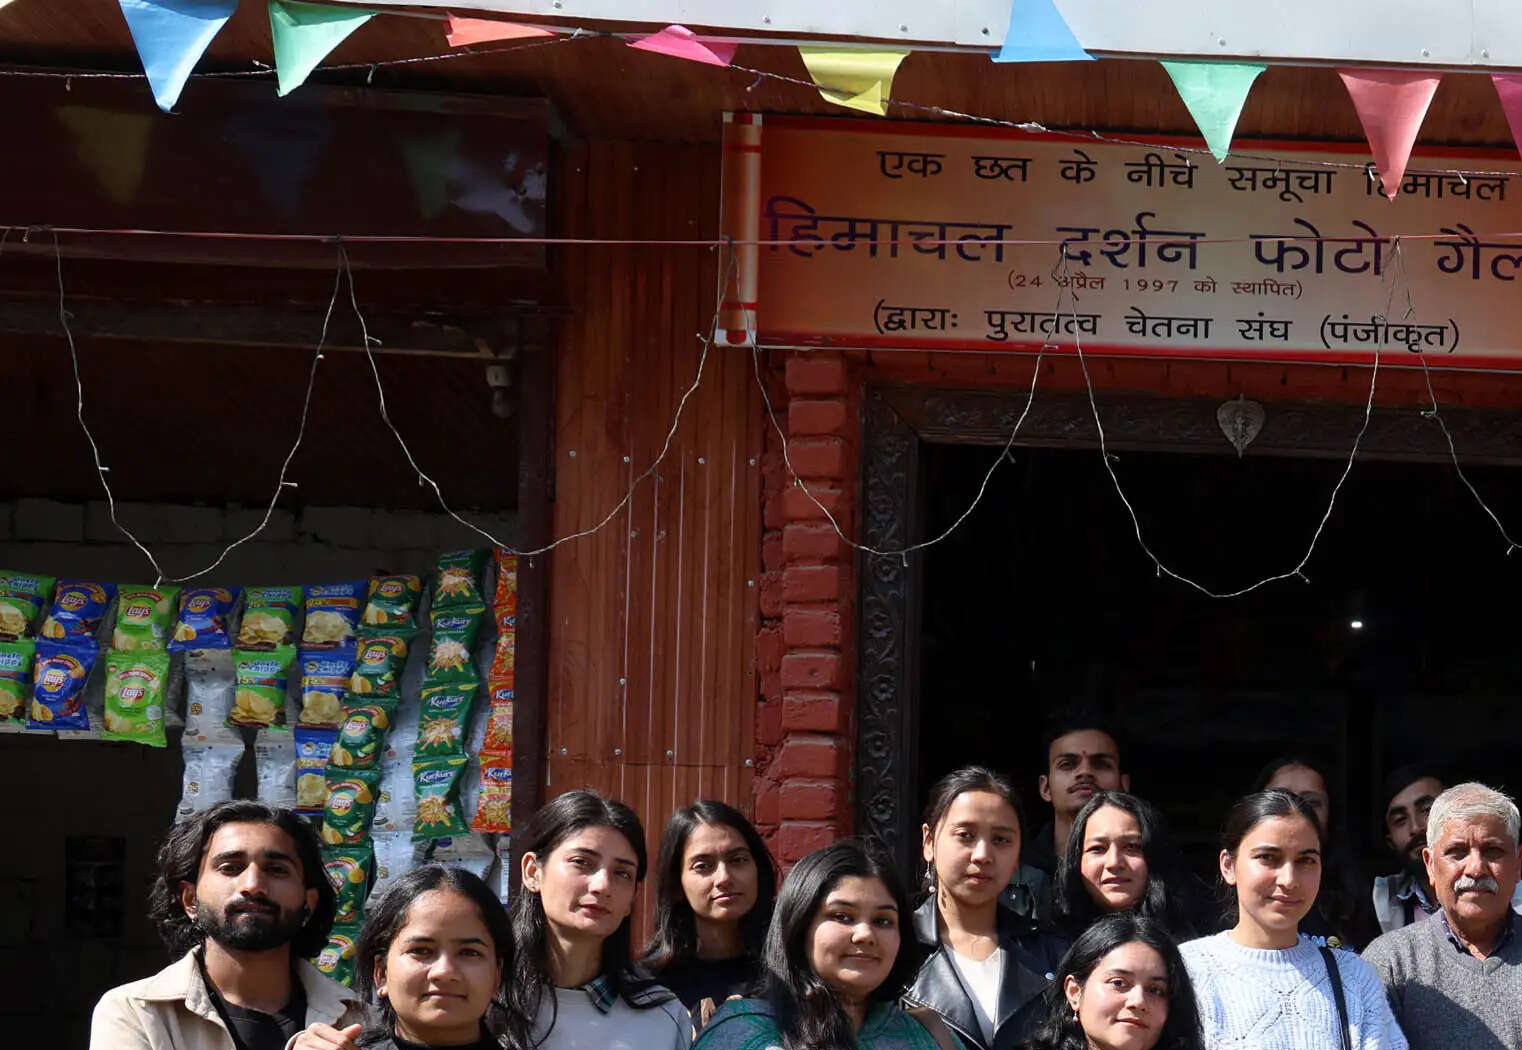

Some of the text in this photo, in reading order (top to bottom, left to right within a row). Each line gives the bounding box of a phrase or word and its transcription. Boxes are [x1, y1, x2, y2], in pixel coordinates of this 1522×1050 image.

[877, 151, 946, 179] एक
[971, 156, 1032, 182] छत
[1059, 150, 1097, 184] के
[1125, 153, 1198, 188] नीचे
[1225, 166, 1336, 203] समूचा
[764, 196, 1013, 264] हिमाचल
[1056, 212, 1206, 269] दर्शन
[1249, 218, 1390, 276] फोटो
[1123, 278, 1178, 293] 1997
[1194, 276, 1216, 294] को
[984, 309, 1101, 341] पुरातत्व
[1125, 306, 1213, 339] चेतना
[1236, 312, 1293, 342] संघ
